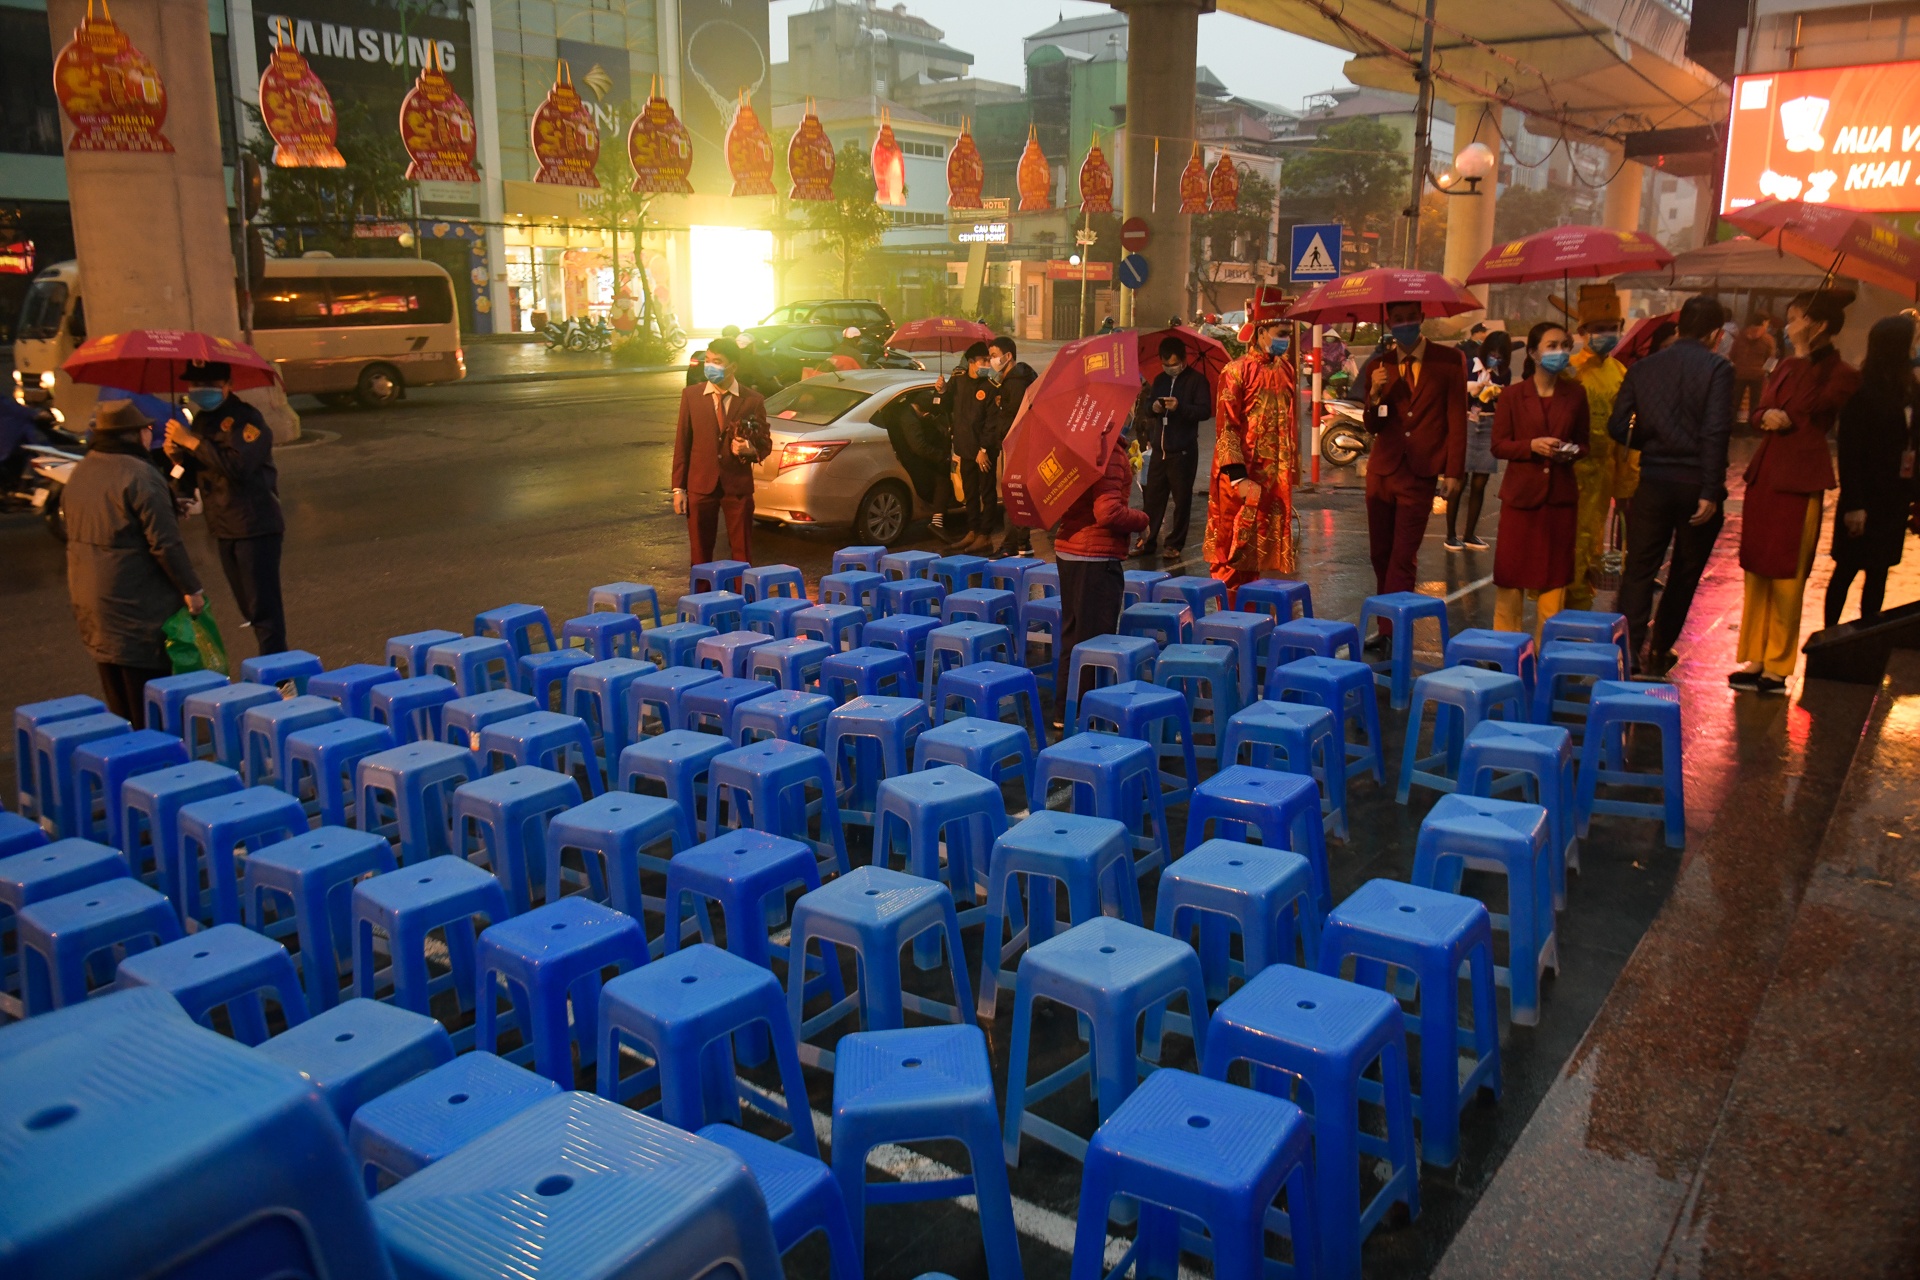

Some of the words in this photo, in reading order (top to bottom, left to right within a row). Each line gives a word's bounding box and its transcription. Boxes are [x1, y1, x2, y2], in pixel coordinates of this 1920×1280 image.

[267, 14, 457, 72] SAMSUNG
[1832, 126, 1892, 154] MUA
[1844, 160, 1911, 191] KHAI
[983, 201, 1006, 209] HOTEL
[974, 224, 988, 233] CAU
[958, 233, 984, 242] CENTER
[985, 233, 1006, 242] POINT
[1067, 408, 1077, 426] TRANG
[1057, 477, 1069, 489] MINH
